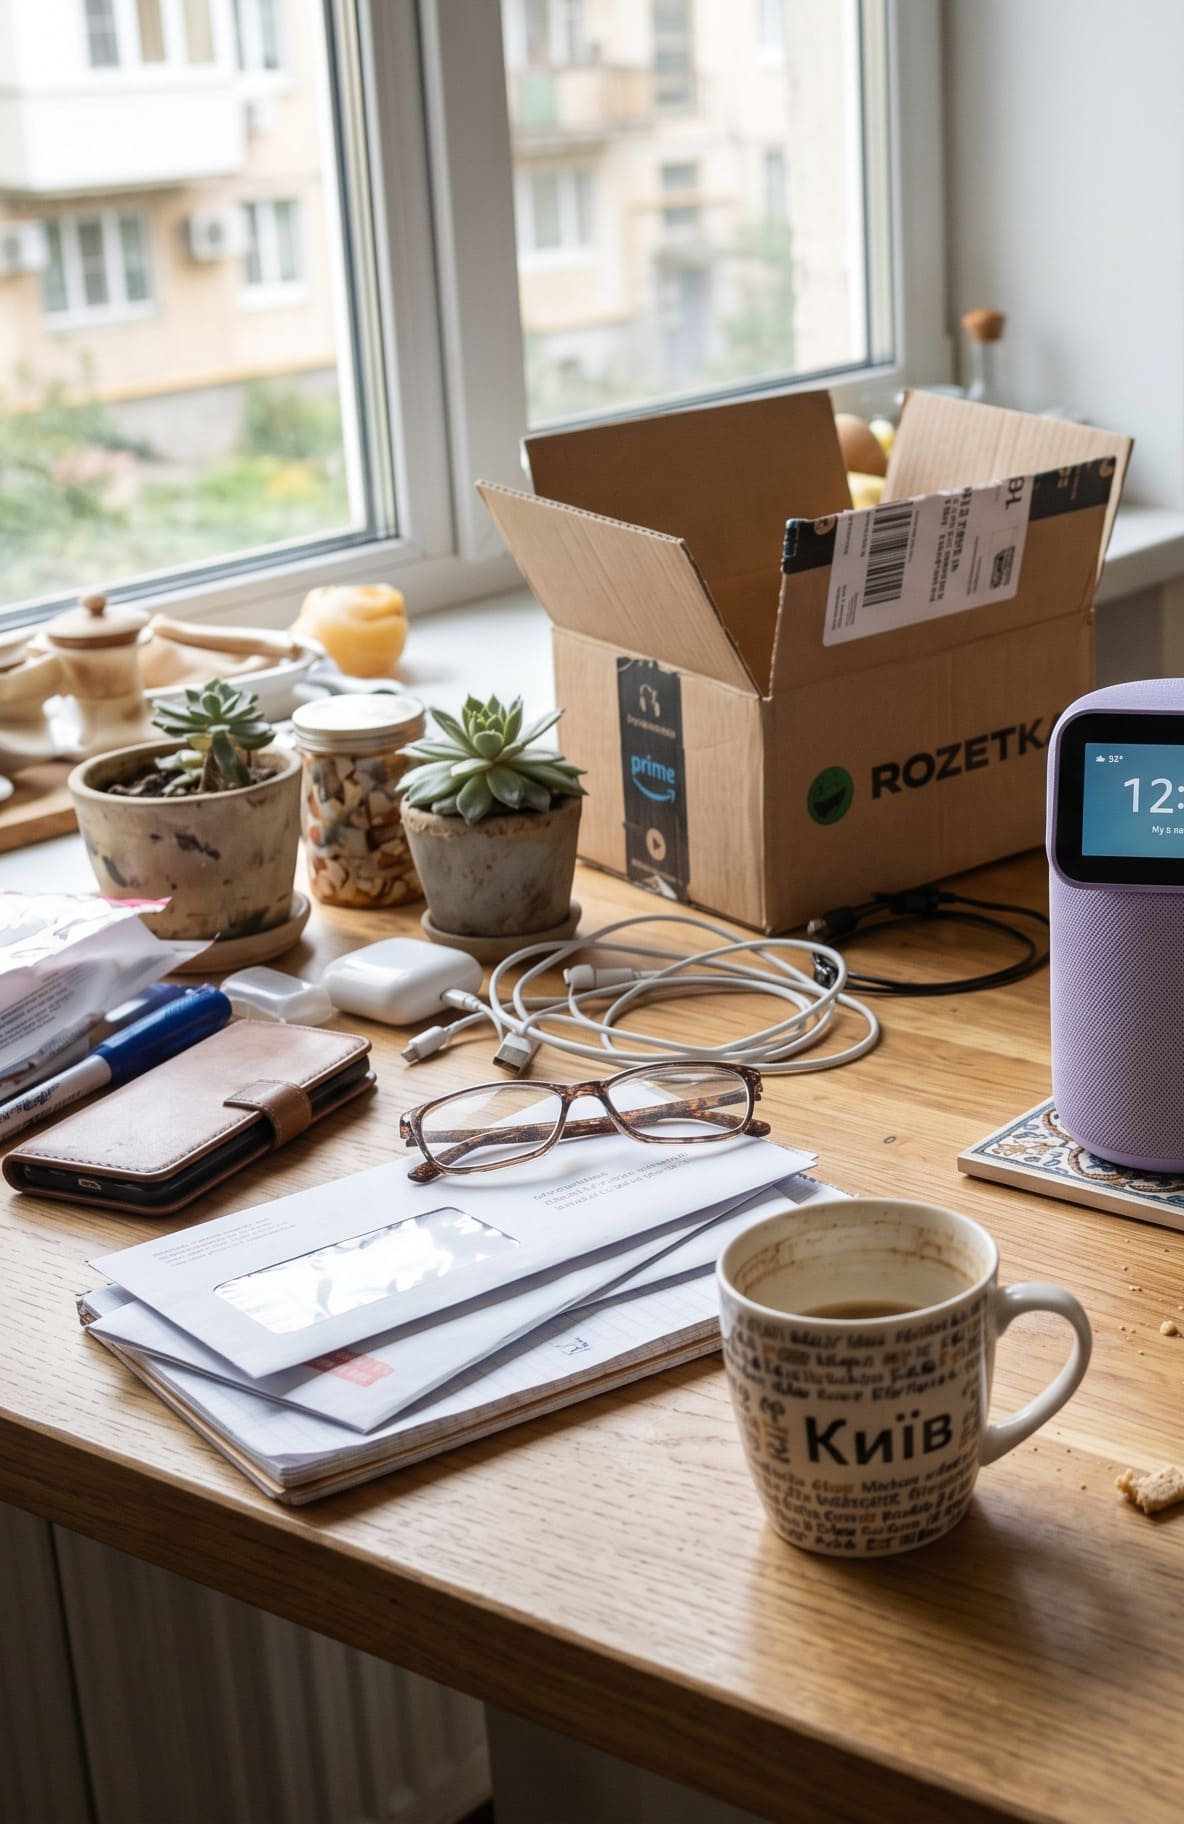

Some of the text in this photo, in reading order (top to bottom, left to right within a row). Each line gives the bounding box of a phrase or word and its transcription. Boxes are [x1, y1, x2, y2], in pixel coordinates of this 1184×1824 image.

[631, 754, 676, 784] prime
[871, 712, 1059, 799] ROZETK
[1152, 825, 1164, 836] My
[804, 1409, 953, 1466] Київ
